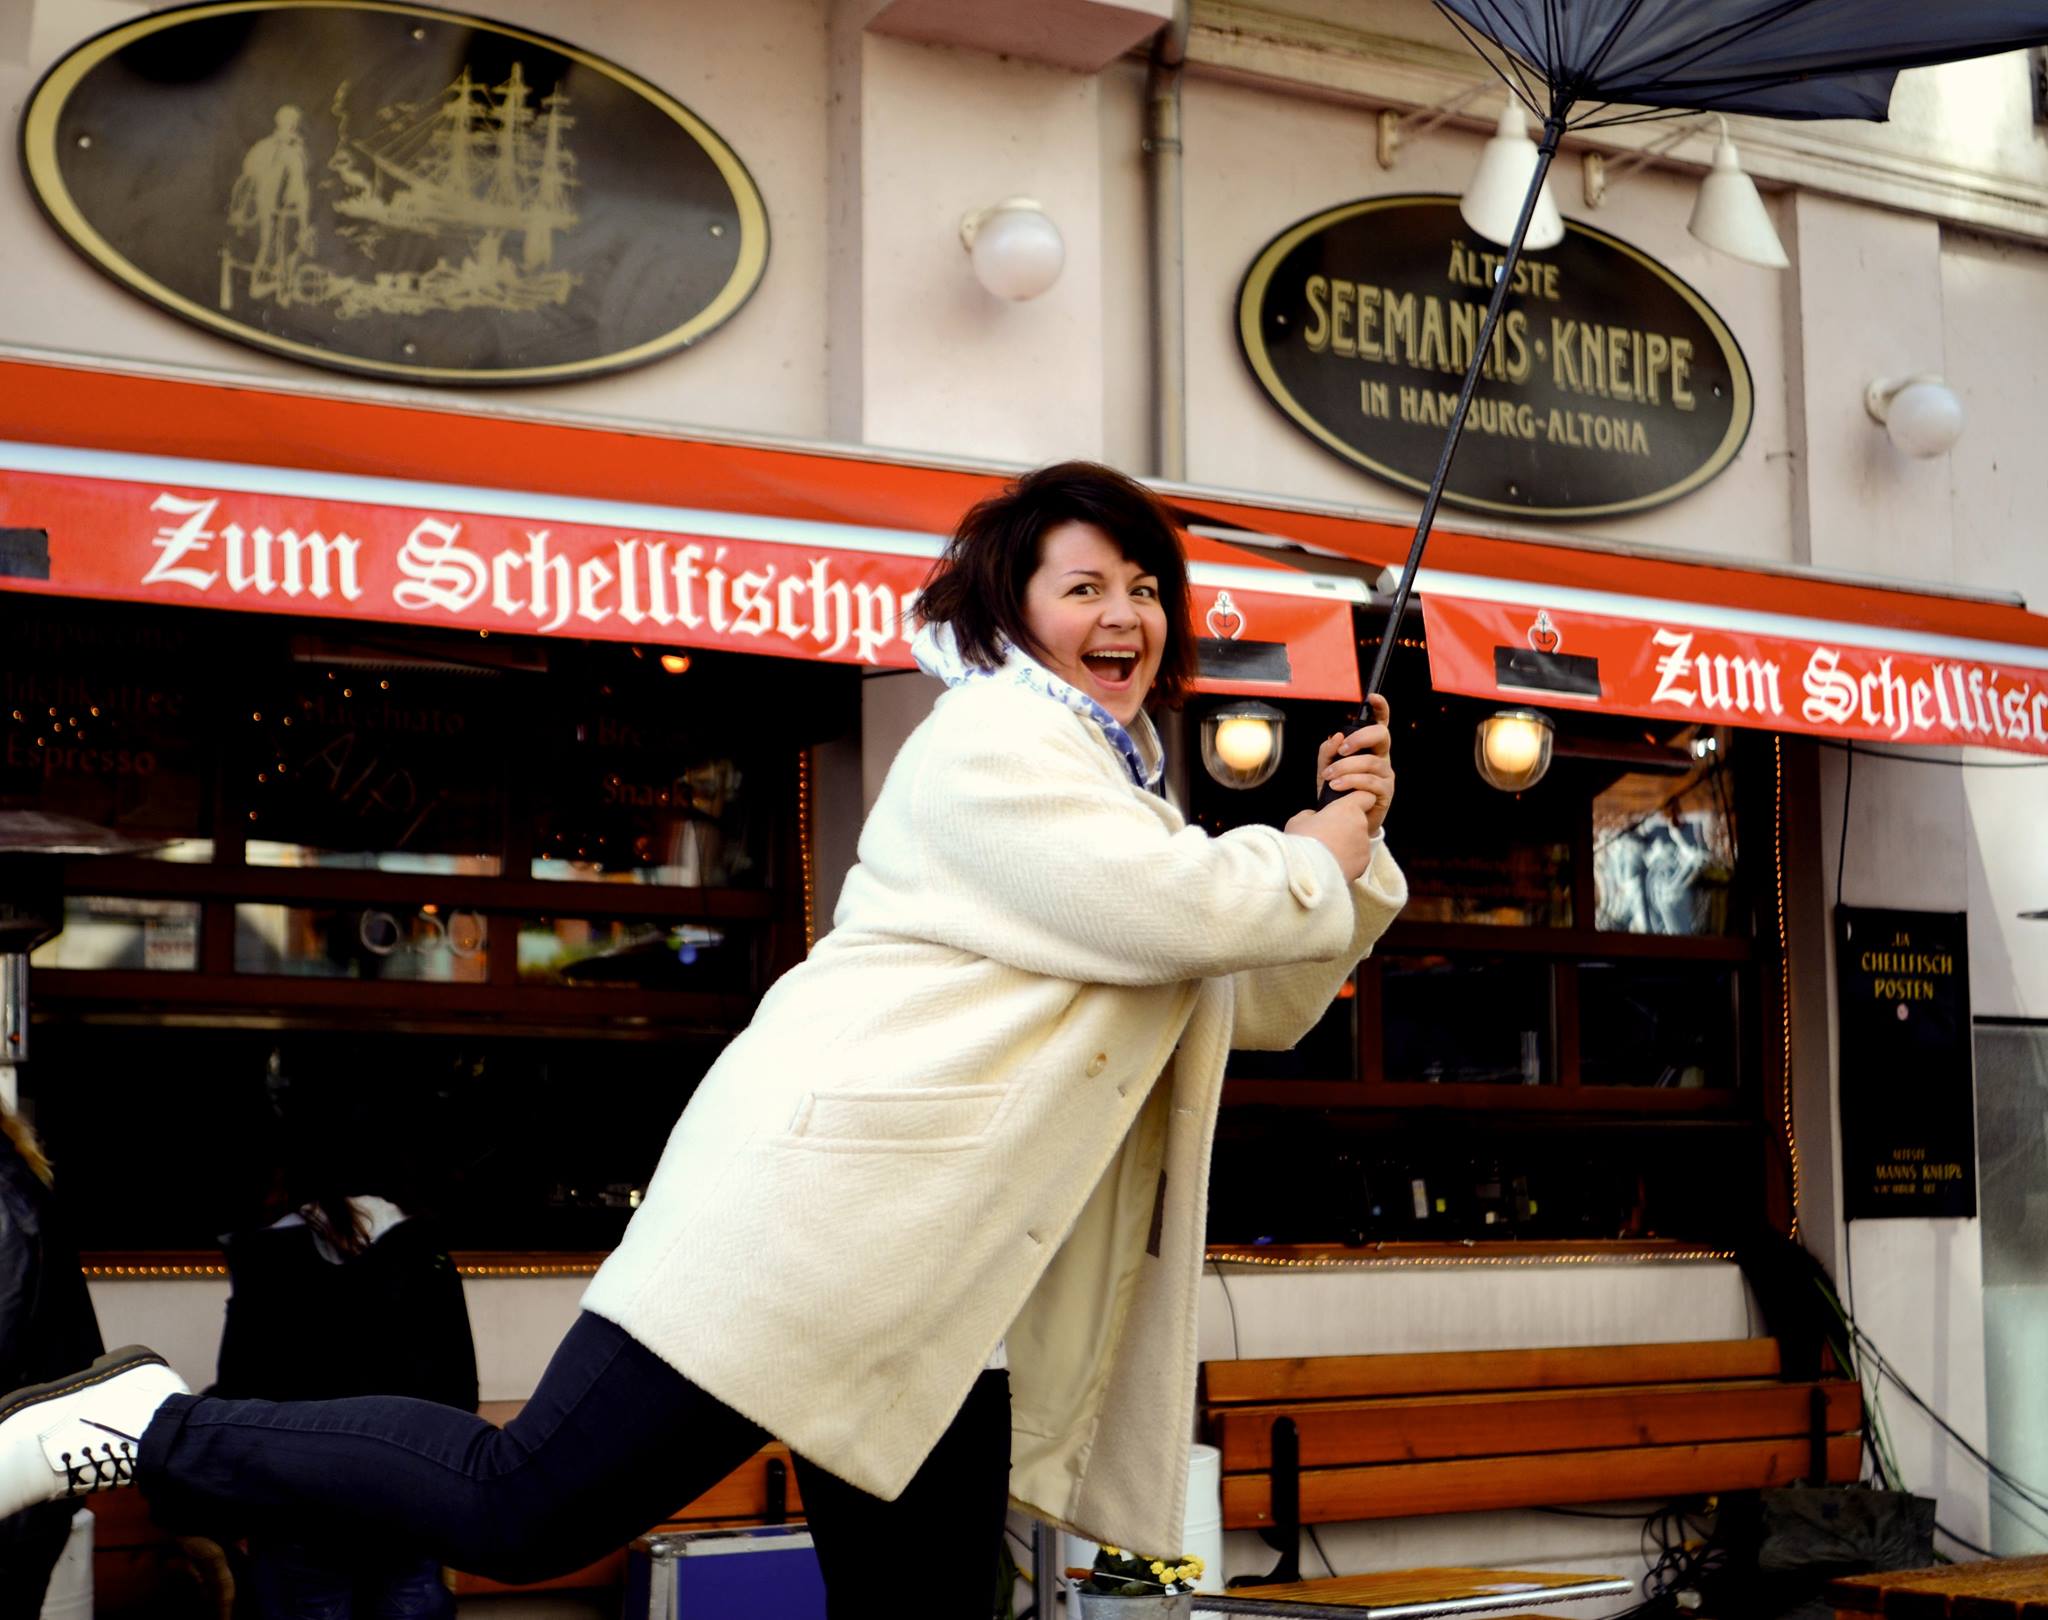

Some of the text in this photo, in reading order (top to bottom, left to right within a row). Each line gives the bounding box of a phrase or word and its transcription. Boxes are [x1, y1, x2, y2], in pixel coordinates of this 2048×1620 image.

[1361, 381, 1388, 420] IN
[141, 492, 364, 601] Zum
[1650, 628, 1783, 716] Zum
[6, 729, 159, 782] Espresso
